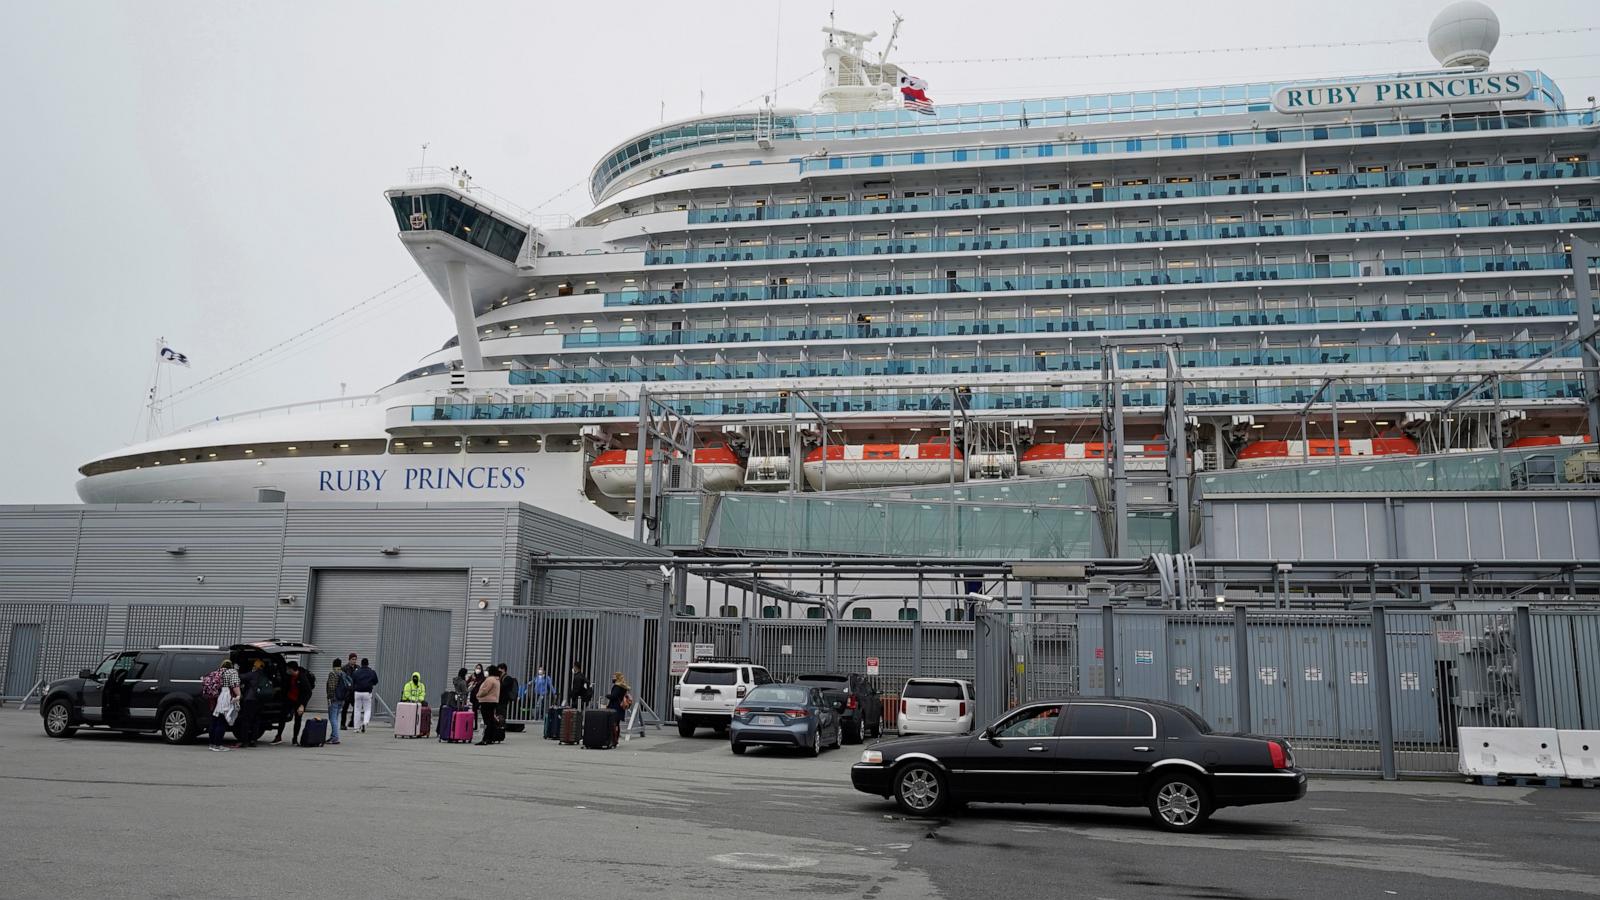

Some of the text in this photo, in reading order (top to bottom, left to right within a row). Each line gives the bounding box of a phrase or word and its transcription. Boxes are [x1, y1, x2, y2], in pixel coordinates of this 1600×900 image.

[1287, 75, 1521, 107] RUBY PRINCESS
[319, 466, 526, 491] RUBY PRINCESS
